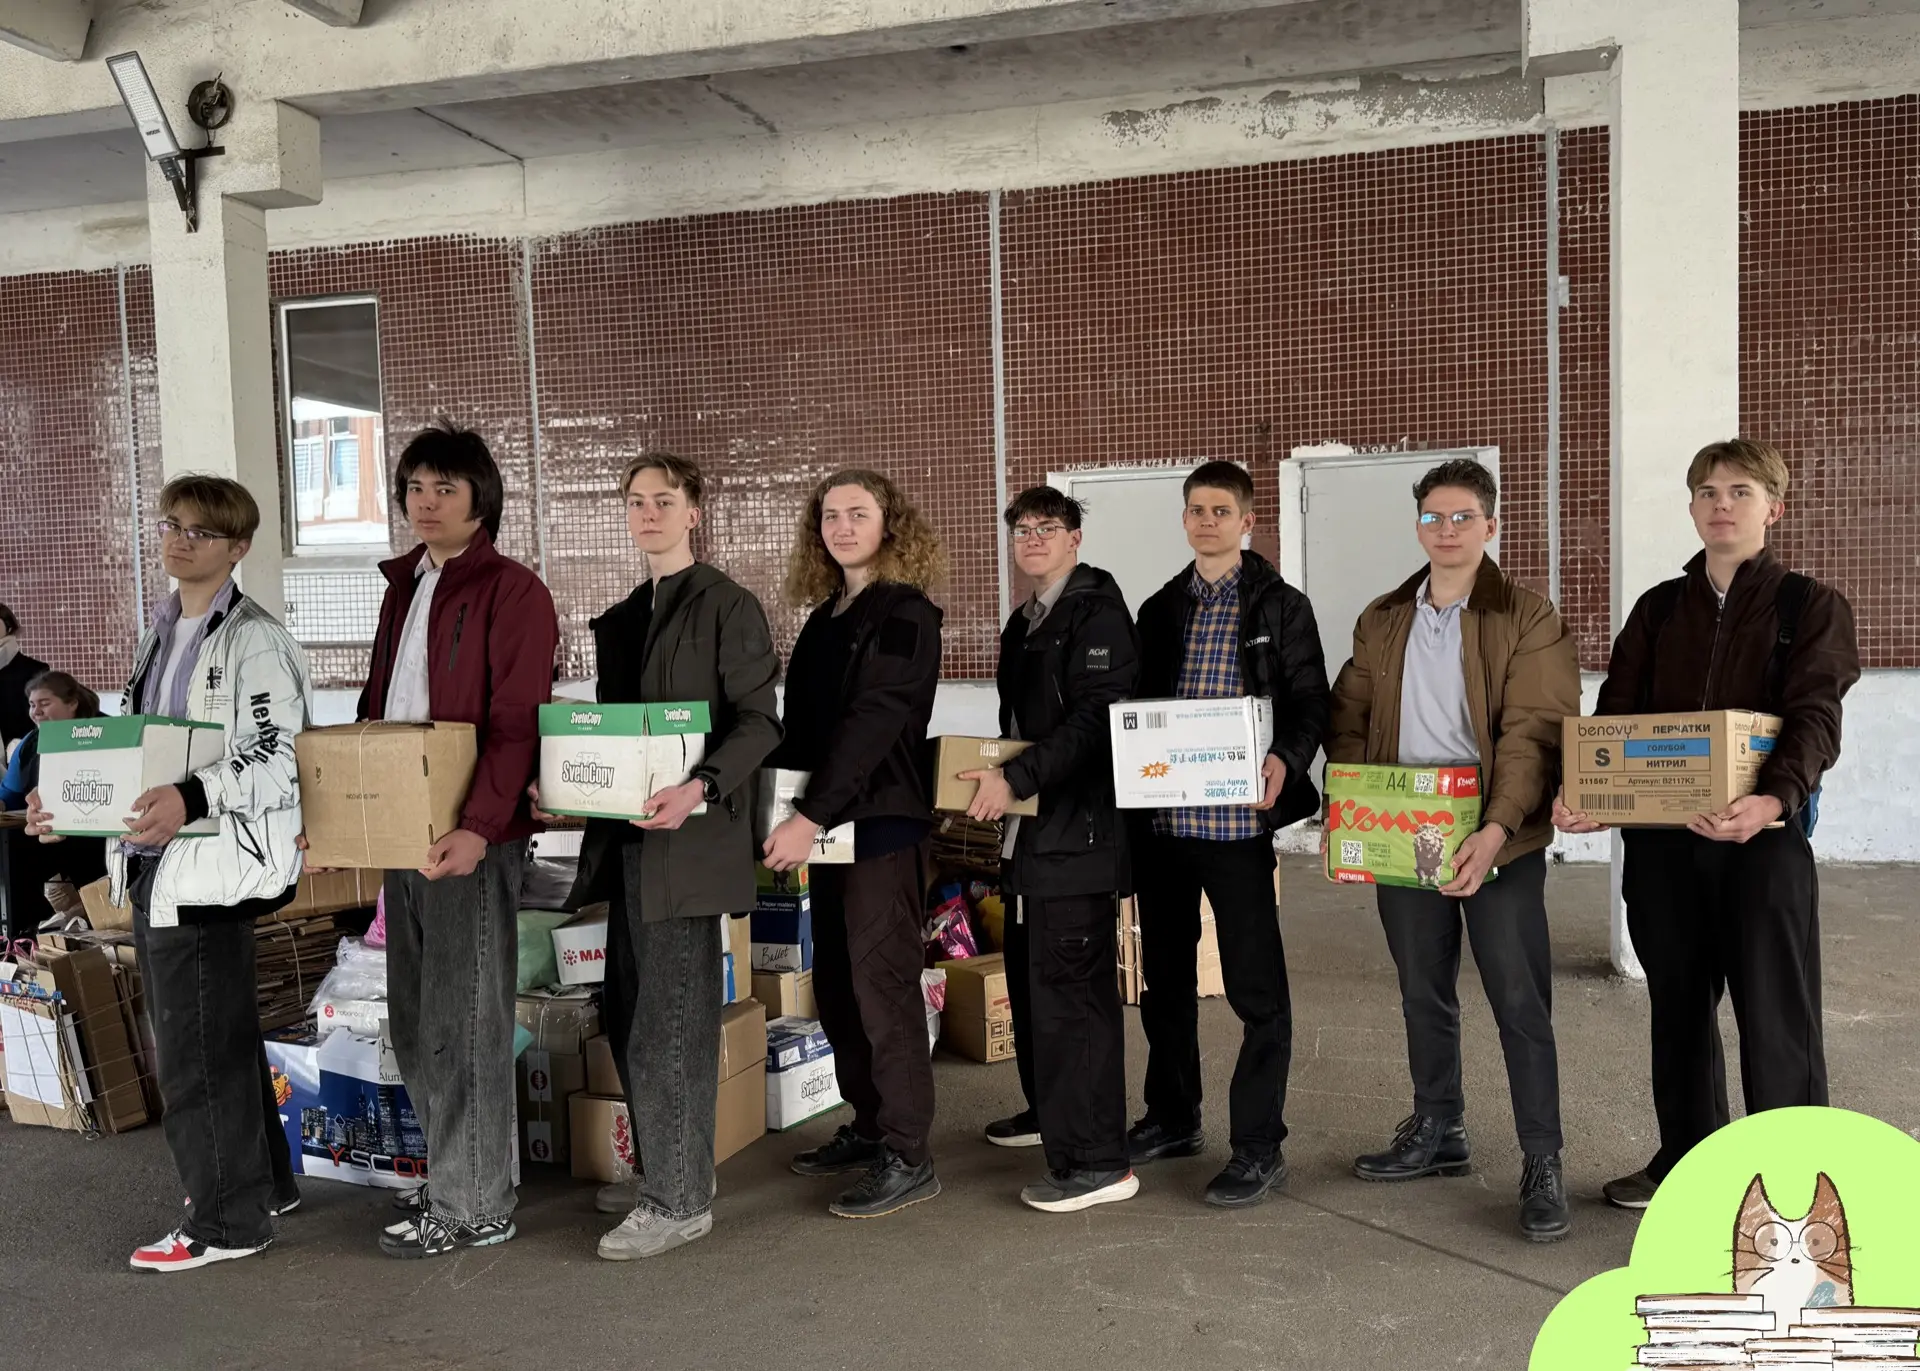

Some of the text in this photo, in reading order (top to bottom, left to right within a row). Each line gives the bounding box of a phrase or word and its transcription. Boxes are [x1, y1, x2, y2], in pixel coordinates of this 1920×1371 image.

[571, 712, 602, 726] SvetoCopy
[1125, 718, 1136, 729] M
[72, 725, 103, 739] SvetoCopy
[1652, 724, 1711, 734] ПЕРЧАТКИ
[1647, 743, 1686, 752] ГОЛУБОЙ
[1594, 747, 1611, 767] S
[1646, 759, 1687, 768] НИТРИЛ
[562, 760, 614, 789] SvetoCopy
[1226, 779, 1249, 787] Wally
[1386, 772, 1406, 791] A4
[62, 780, 113, 805] SvetoCopy
[1338, 872, 1365, 882] PREMIUM
